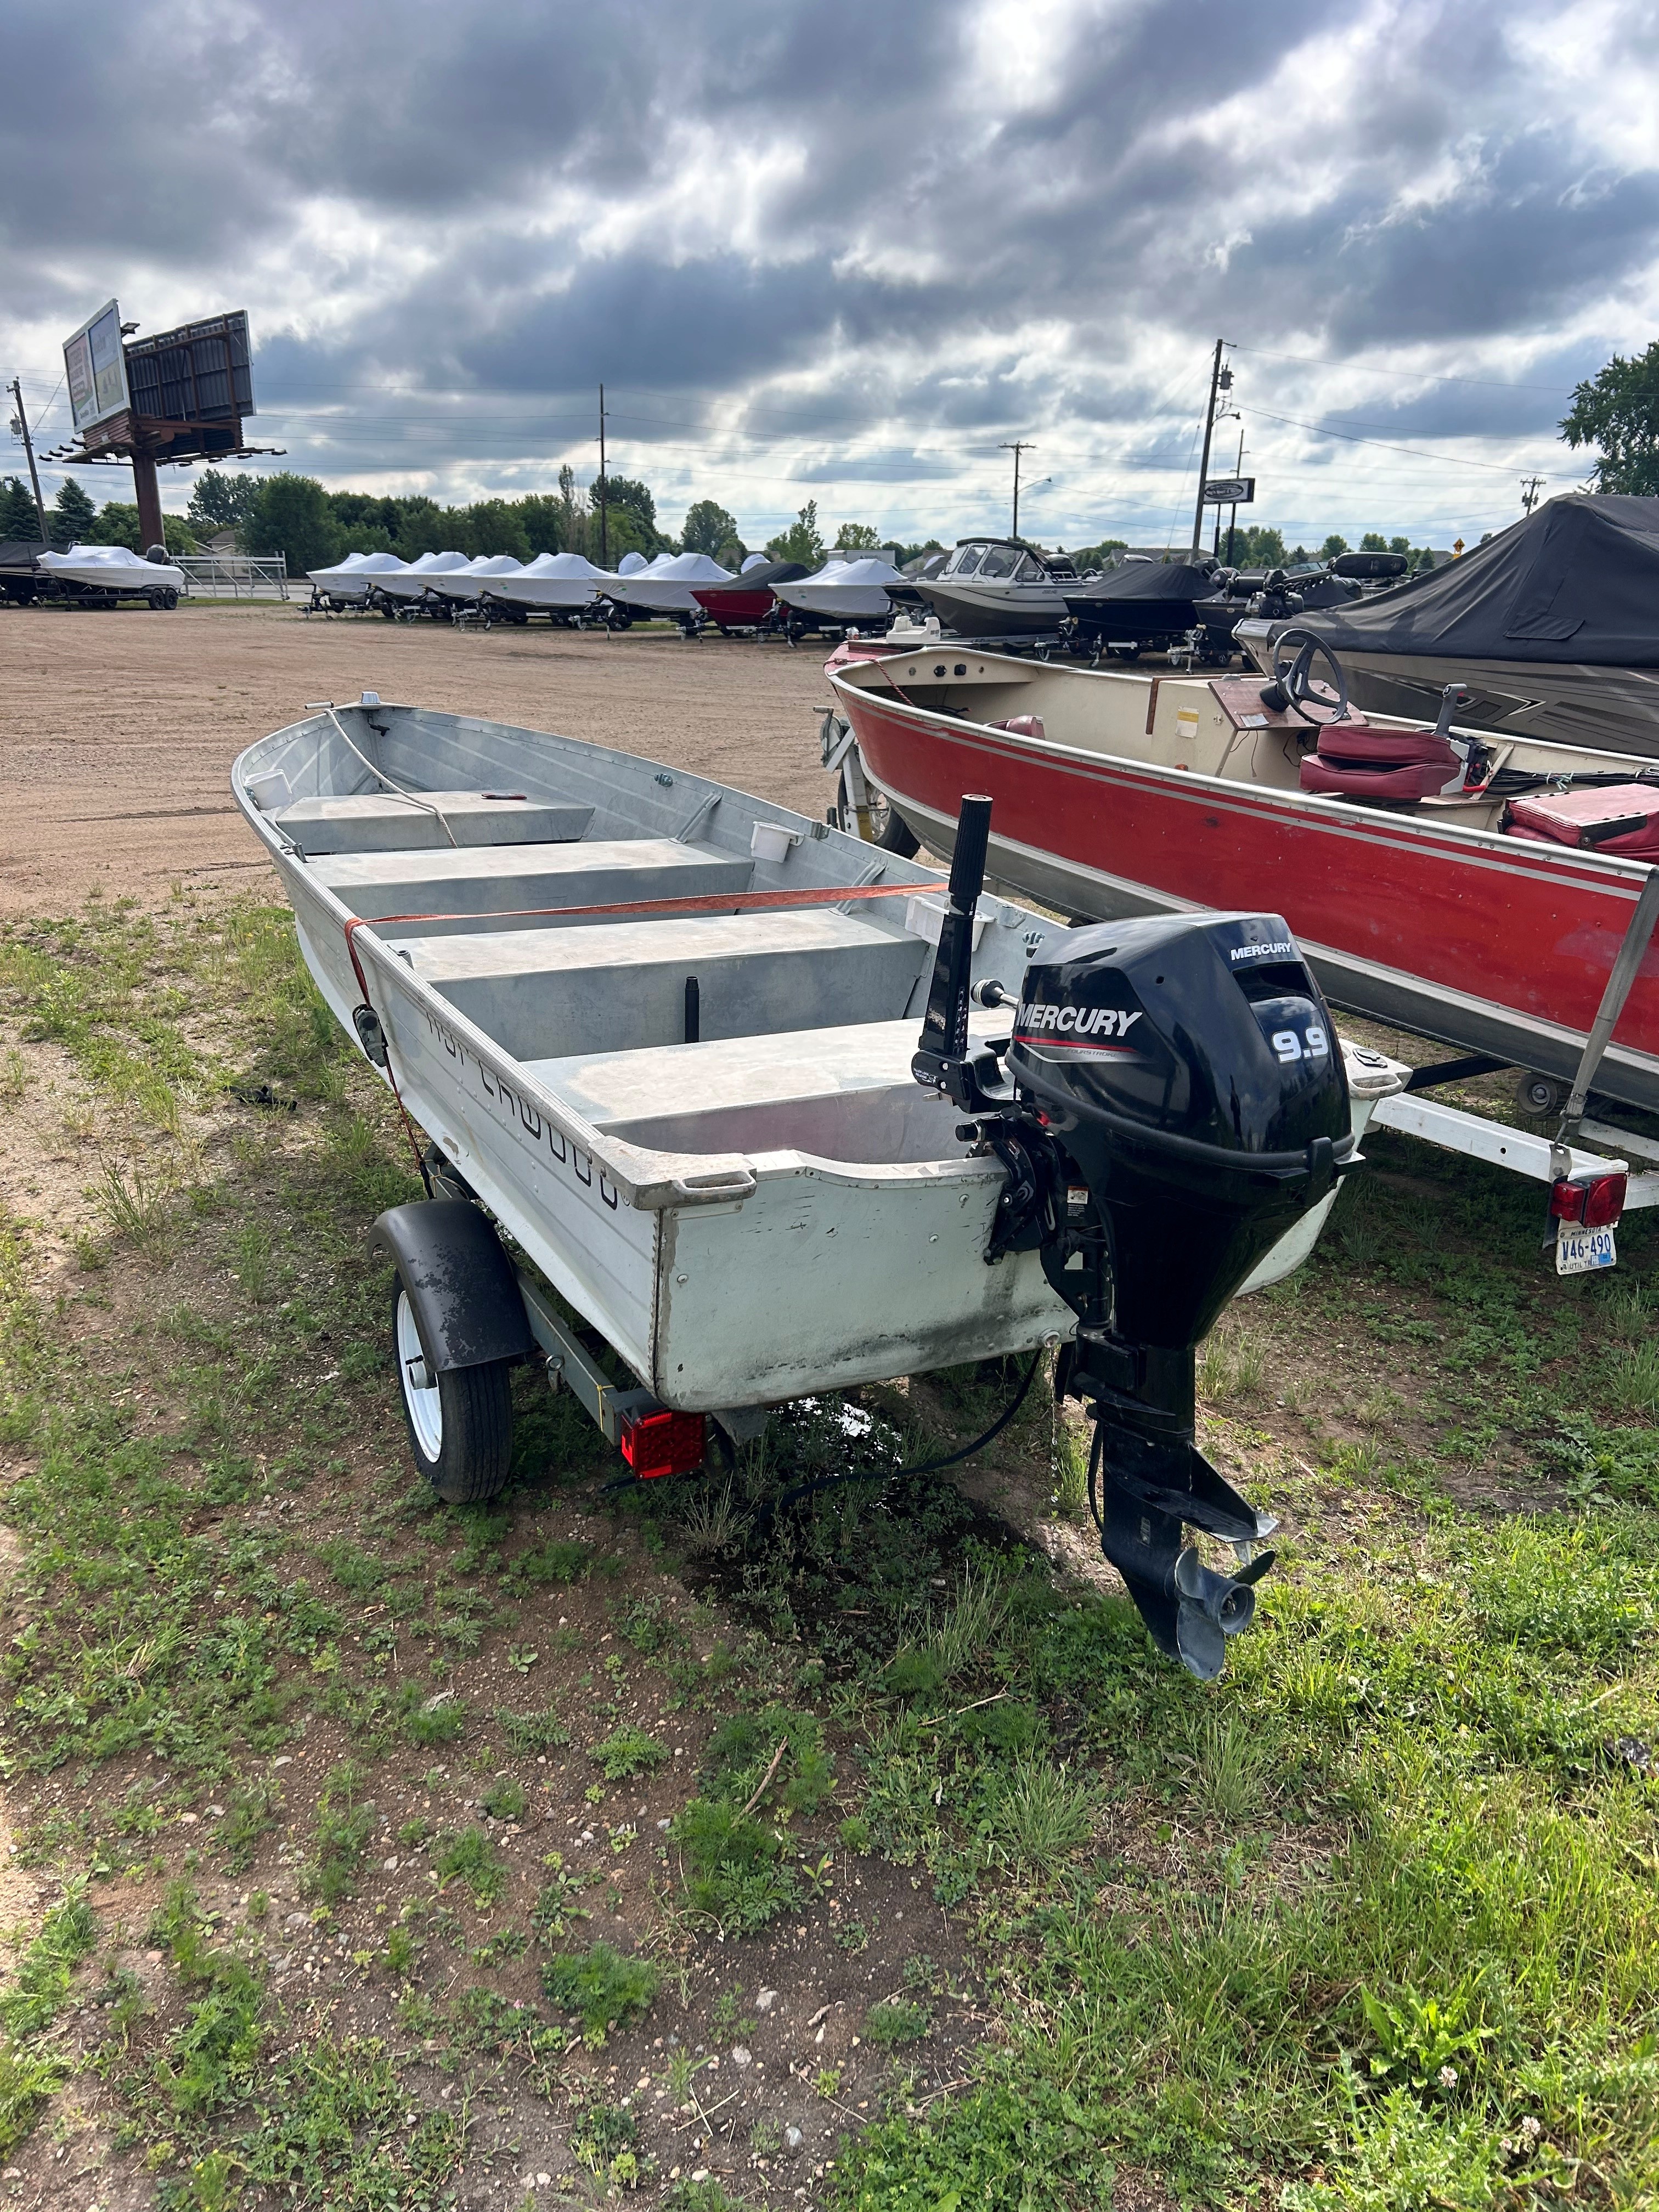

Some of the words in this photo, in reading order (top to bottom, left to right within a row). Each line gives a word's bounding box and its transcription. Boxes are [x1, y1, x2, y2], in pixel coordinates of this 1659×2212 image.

[1231, 943, 1291, 961] MERCURY
[1016, 1003, 1143, 1036] MERCURY
[1272, 1026, 1329, 1063] 9.9
[1570, 1226, 1601, 1237] MINNESOTA
[1562, 1233, 1611, 1261] V46-490
